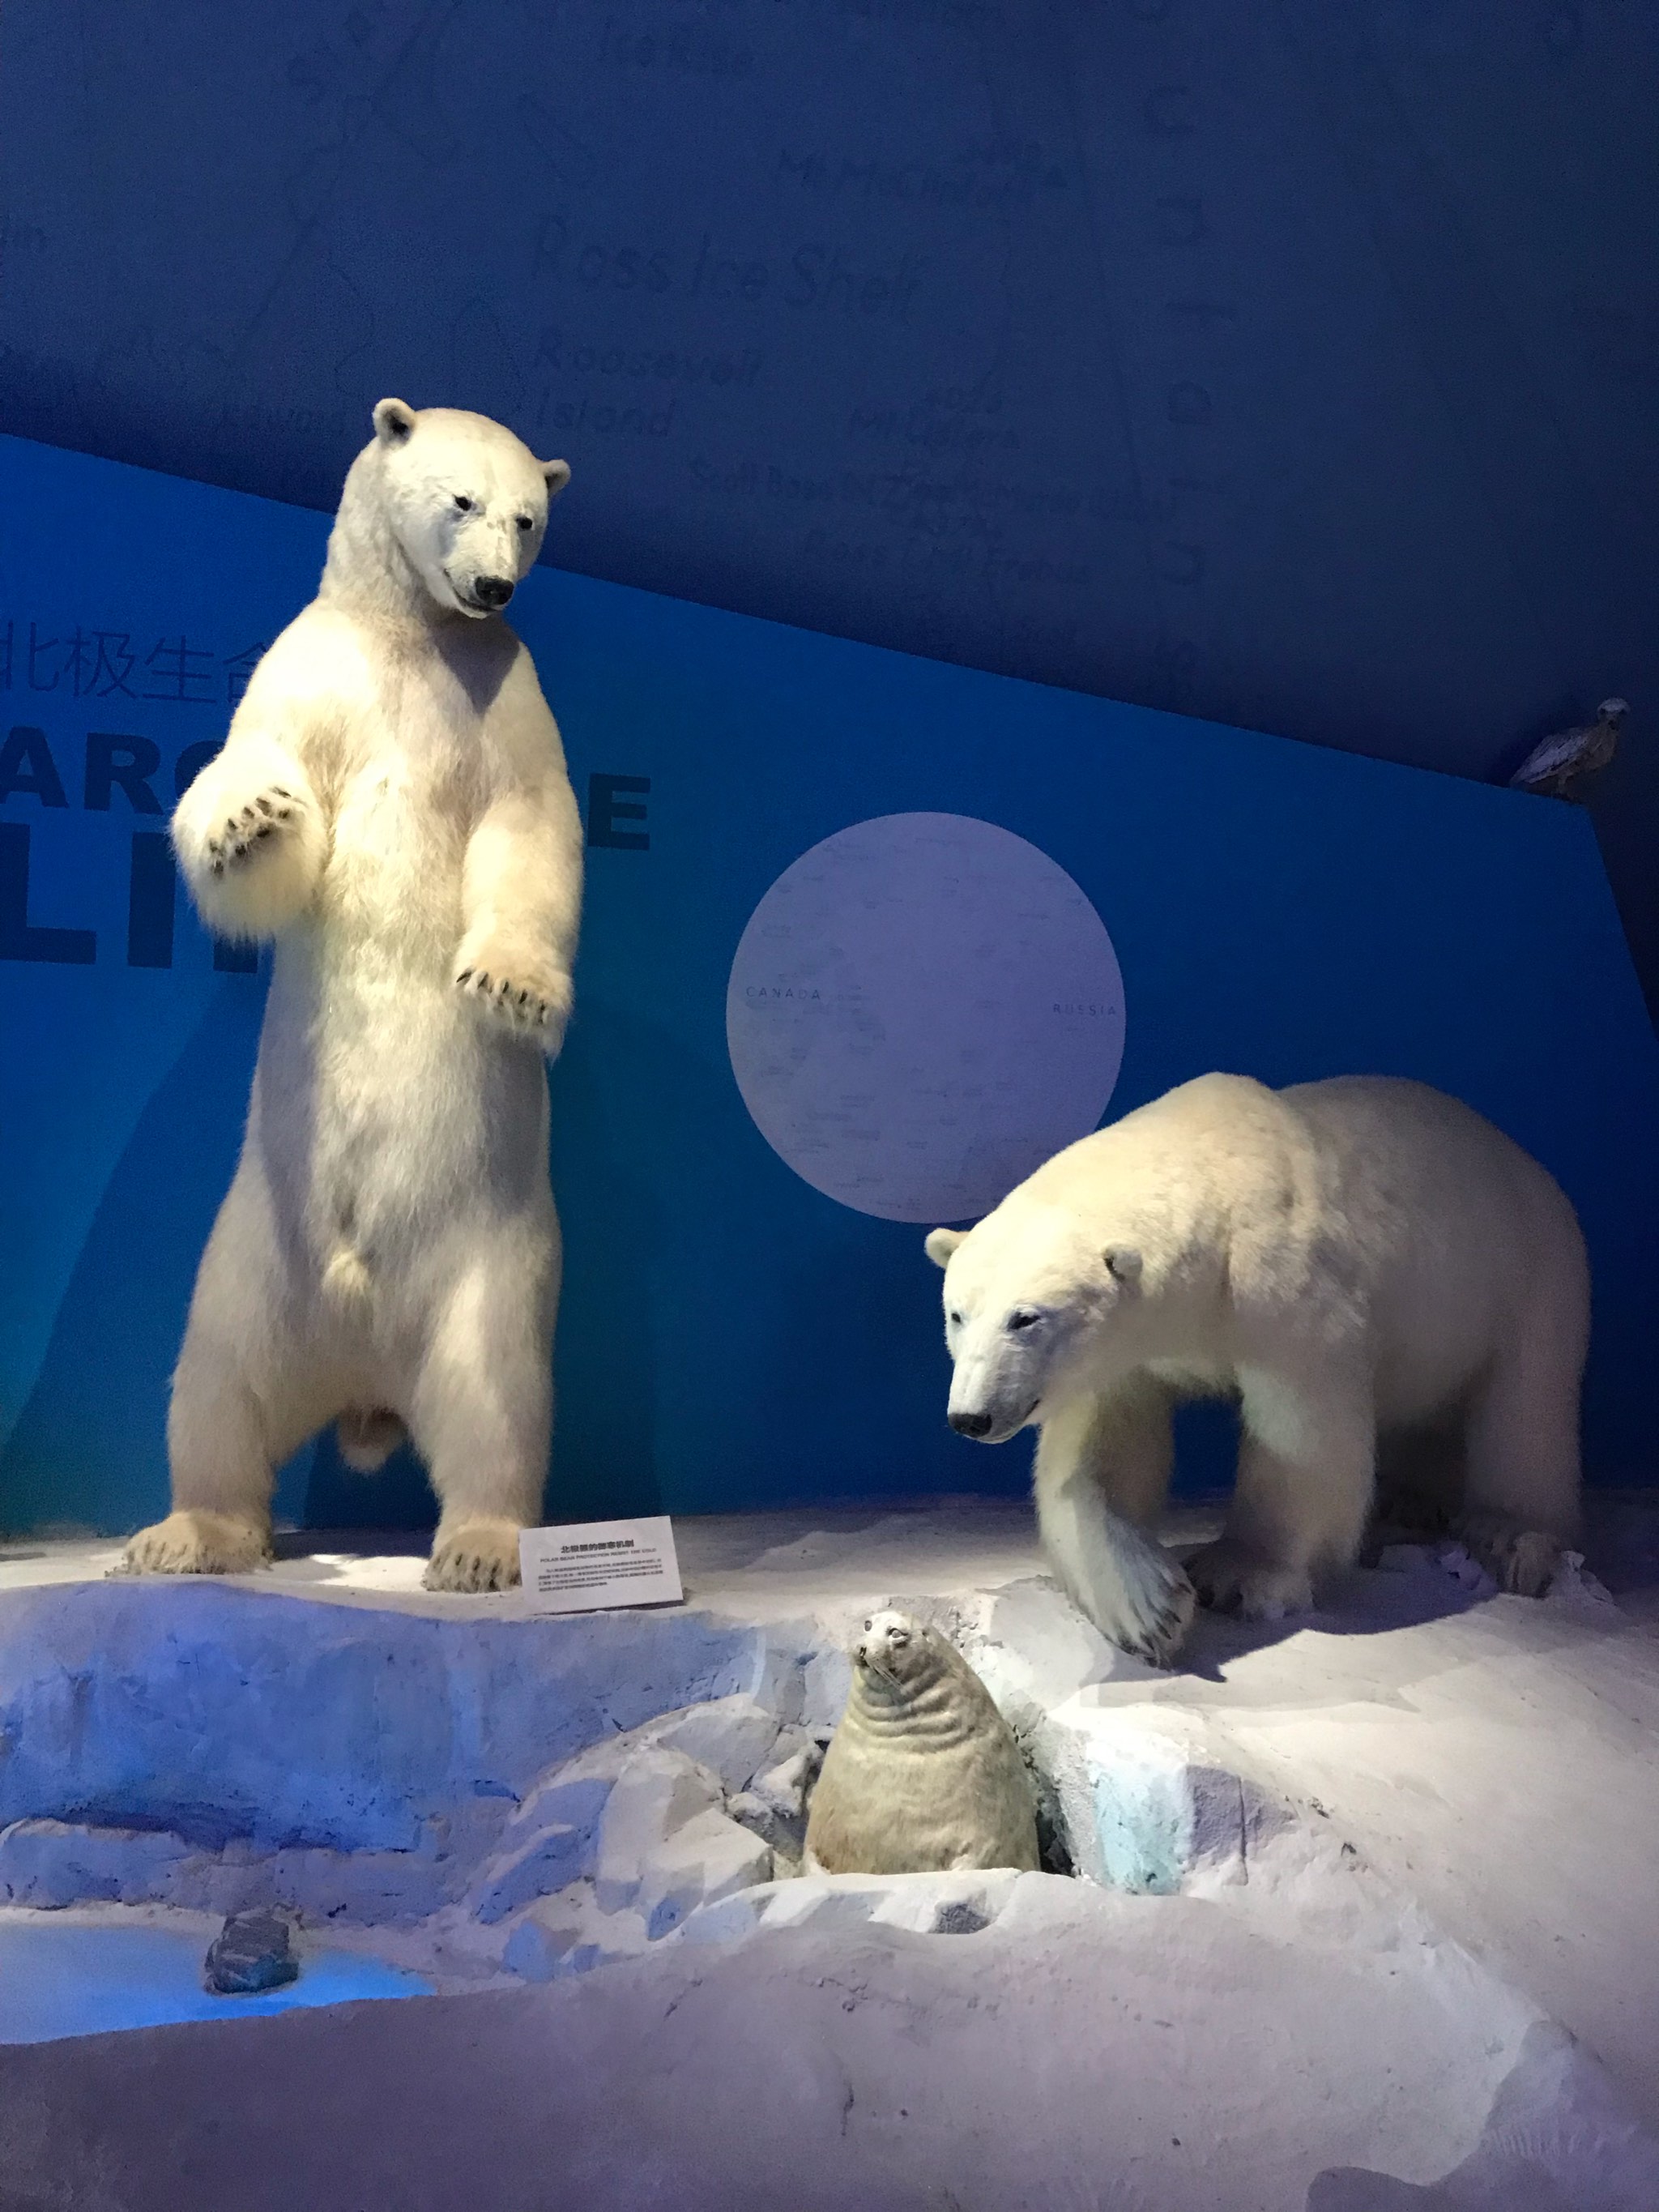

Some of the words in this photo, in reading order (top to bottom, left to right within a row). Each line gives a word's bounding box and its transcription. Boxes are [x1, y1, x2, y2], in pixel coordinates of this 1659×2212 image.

[531, 212, 671, 294] Ross
[687, 232, 769, 302] Ice
[783, 244, 932, 326] Shelf
[535, 386, 676, 438] Island
[745, 986, 822, 1001] CANADA
[1052, 1003, 1118, 1017] RUSSIA
